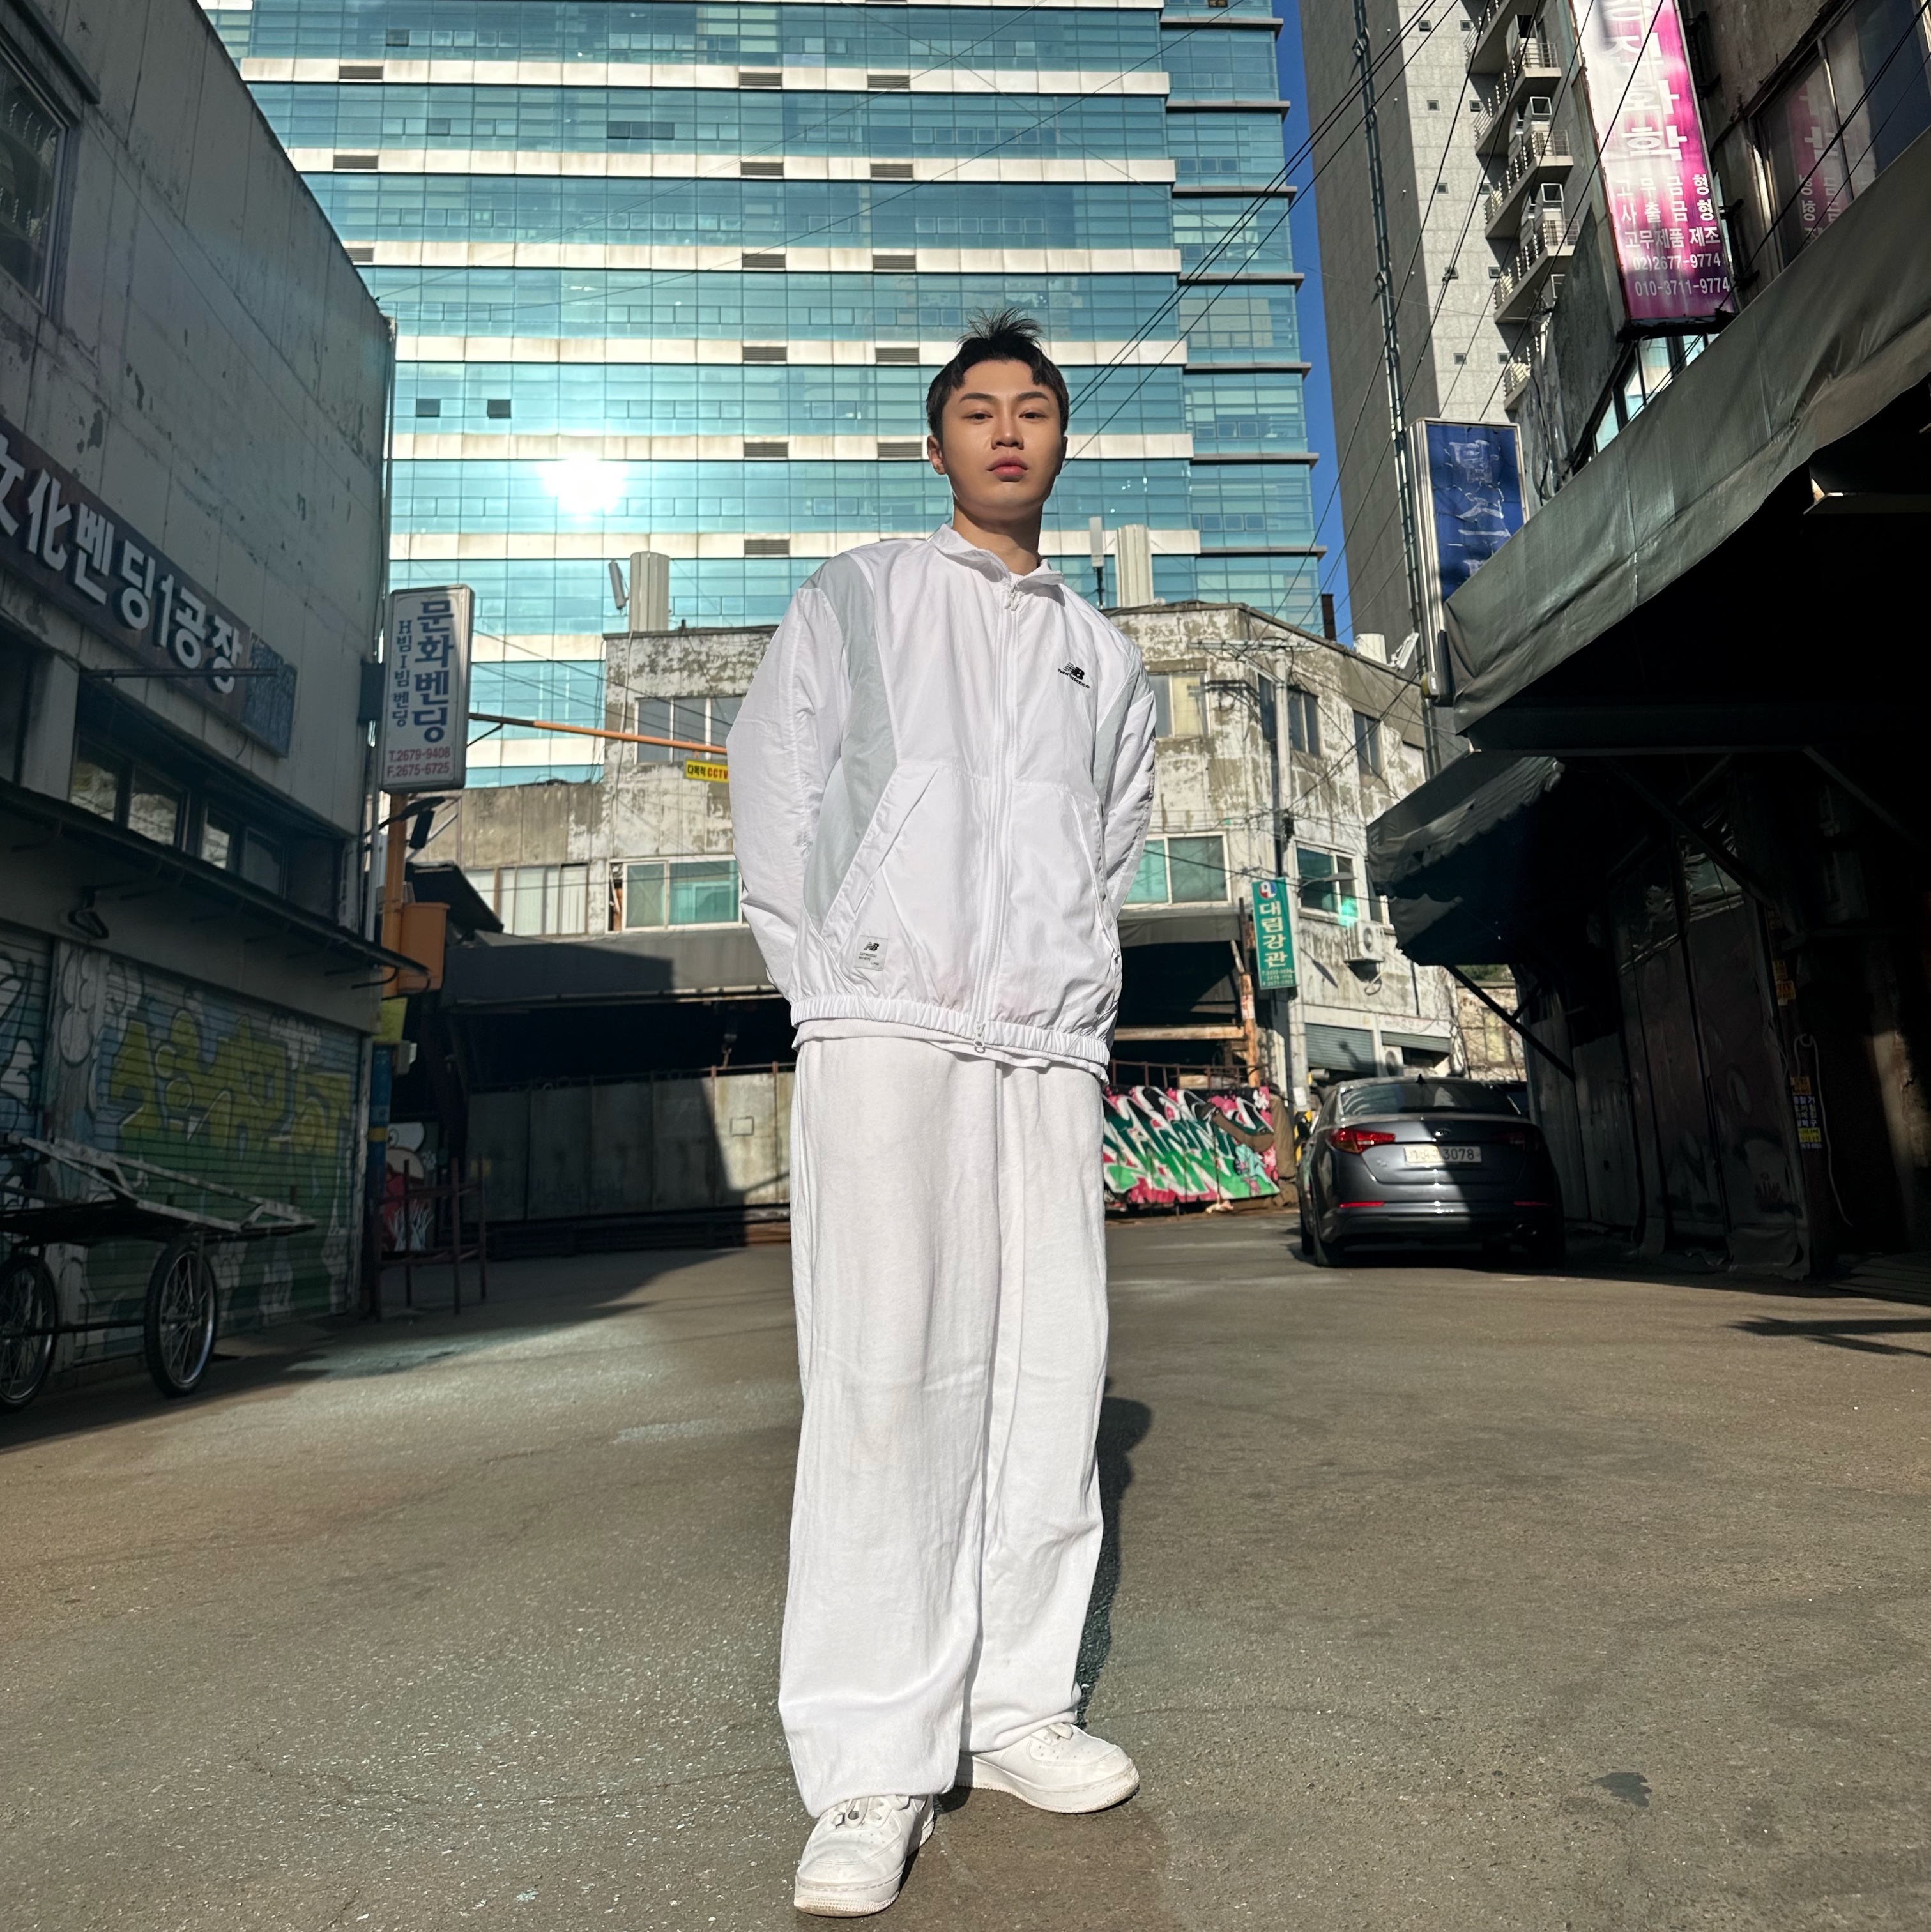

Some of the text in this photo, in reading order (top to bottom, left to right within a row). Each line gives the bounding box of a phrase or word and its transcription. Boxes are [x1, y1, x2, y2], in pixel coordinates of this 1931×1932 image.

[1624, 227, 1721, 250] 고무제품 제조
[1633, 253, 1721, 271] 02)2677-9774
[1635, 277, 1730, 297] 010-3711-9774
[411, 599, 455, 743] 문화벤딩
[1443, 1148, 1474, 1160] 3078
